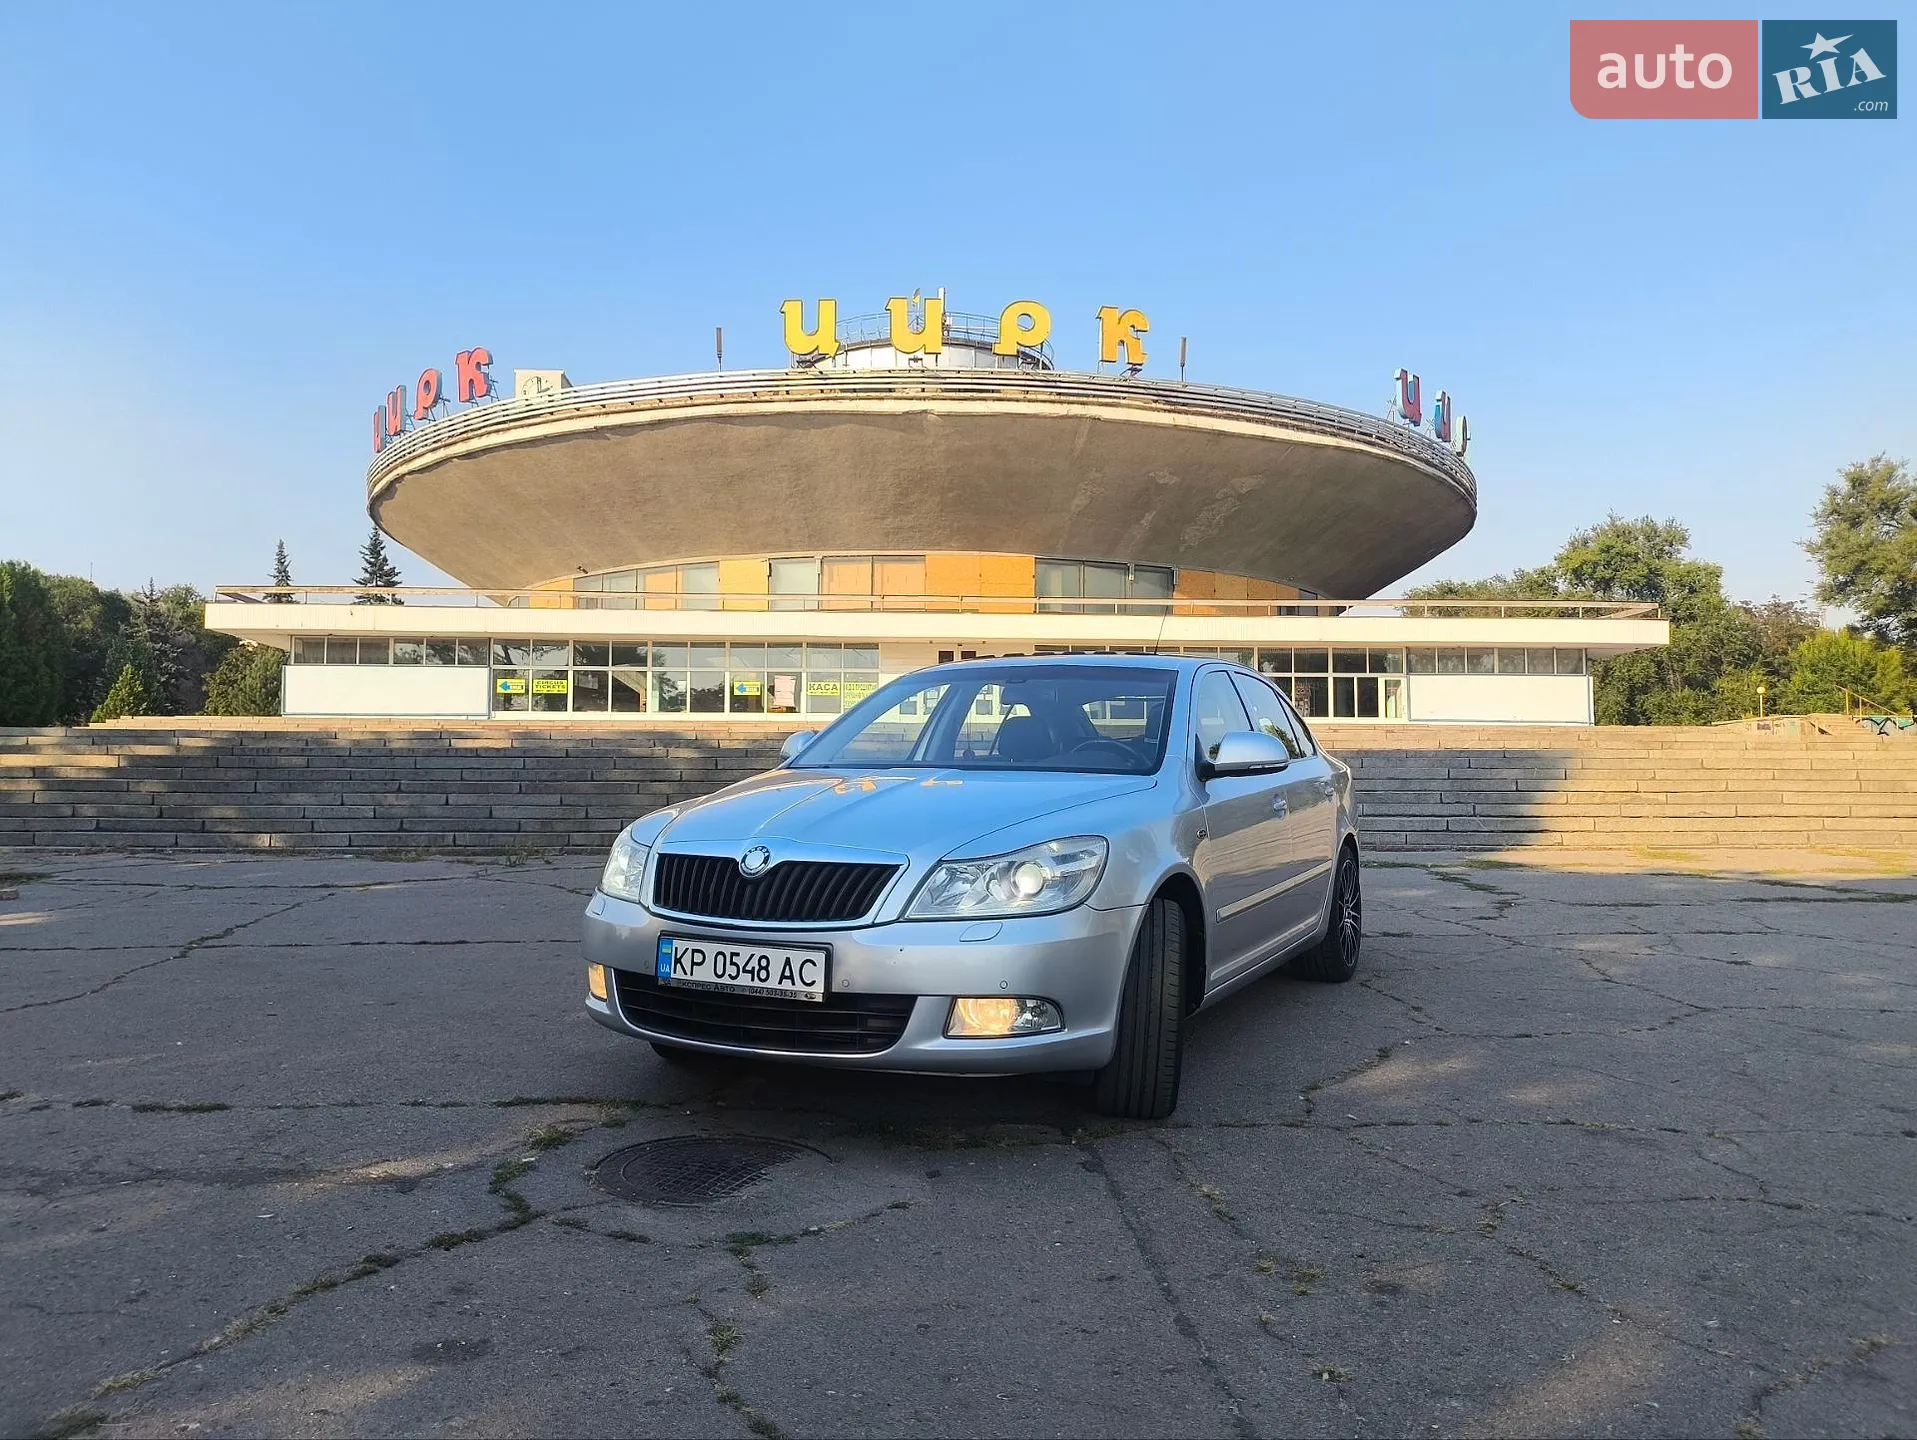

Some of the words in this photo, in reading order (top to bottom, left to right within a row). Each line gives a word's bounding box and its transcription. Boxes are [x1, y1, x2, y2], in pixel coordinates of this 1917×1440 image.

[660, 964, 670, 973] UA
[673, 946, 707, 976] KP
[713, 950, 771, 983] 0548
[777, 956, 818, 987] AC
